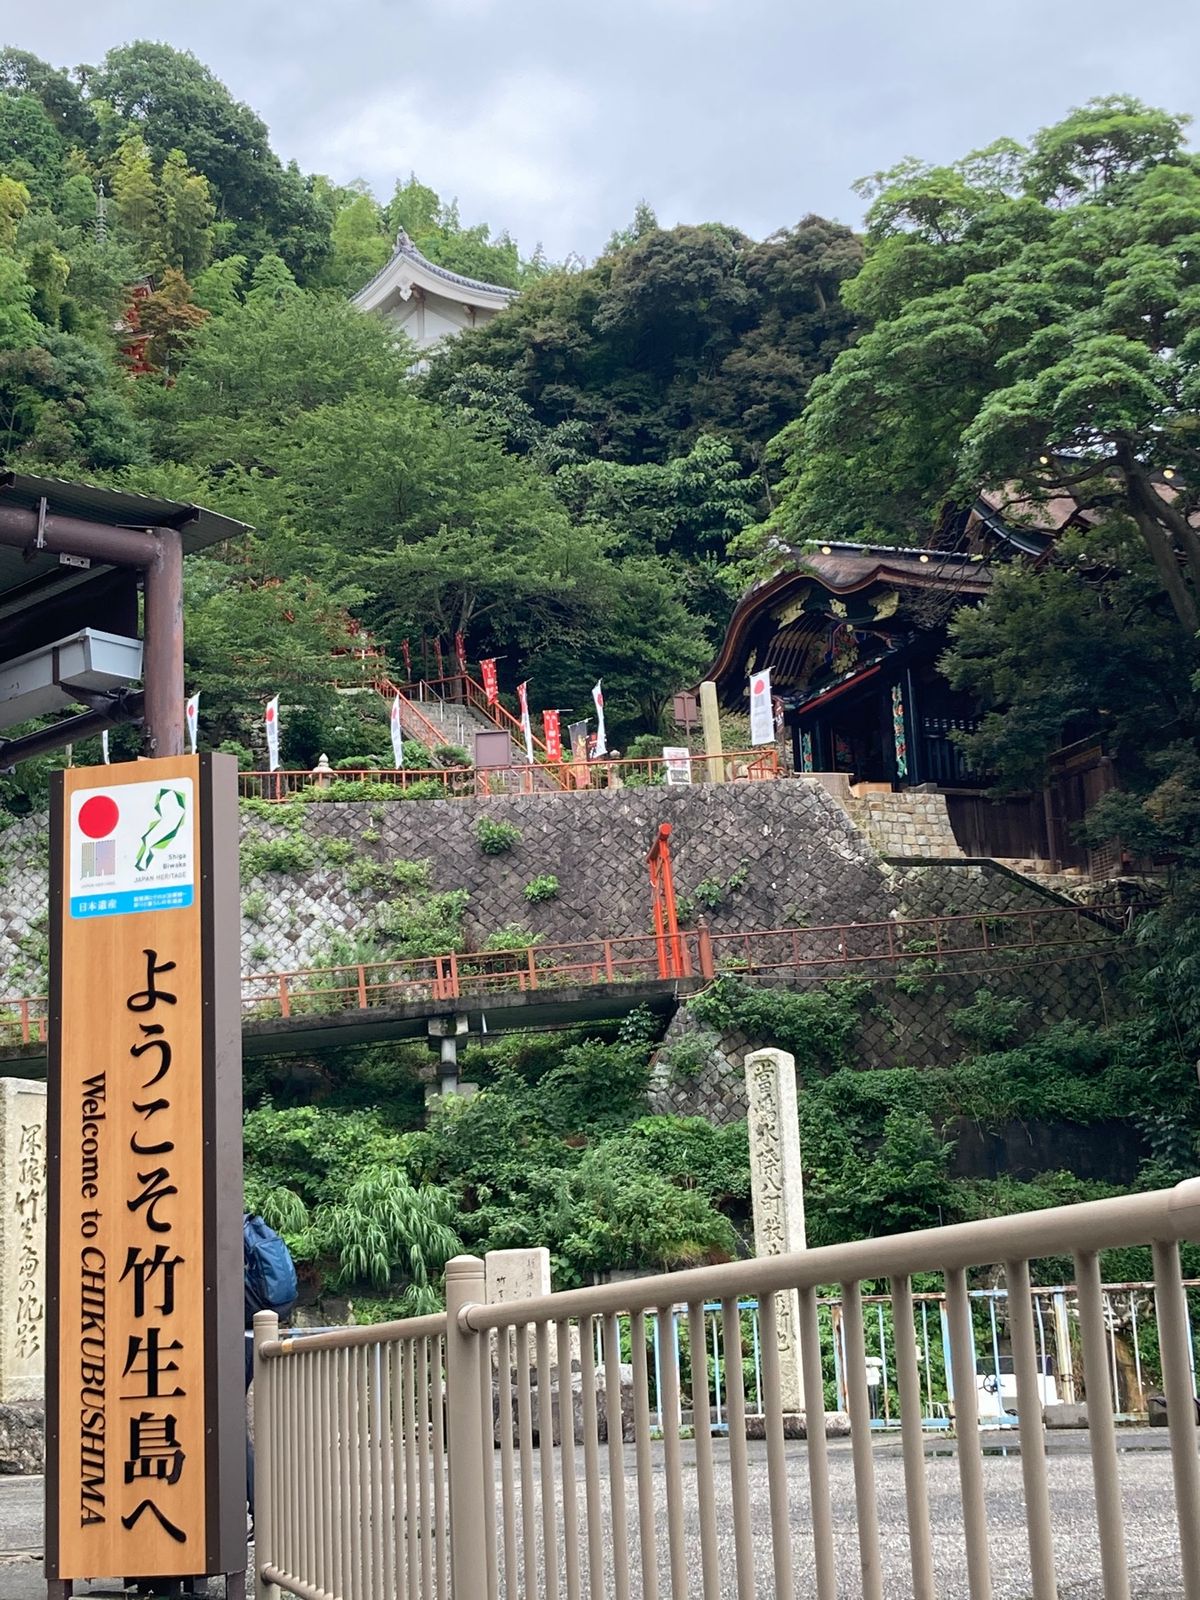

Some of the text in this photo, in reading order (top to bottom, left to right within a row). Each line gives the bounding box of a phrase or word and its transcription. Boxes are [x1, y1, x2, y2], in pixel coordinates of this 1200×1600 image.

[79, 899, 117, 913] 日本遺産
[80, 1069, 107, 1529] Welcome to CHIKUBUSHIMA
[118, 948, 187, 1543] ようこそ竹生島へ
